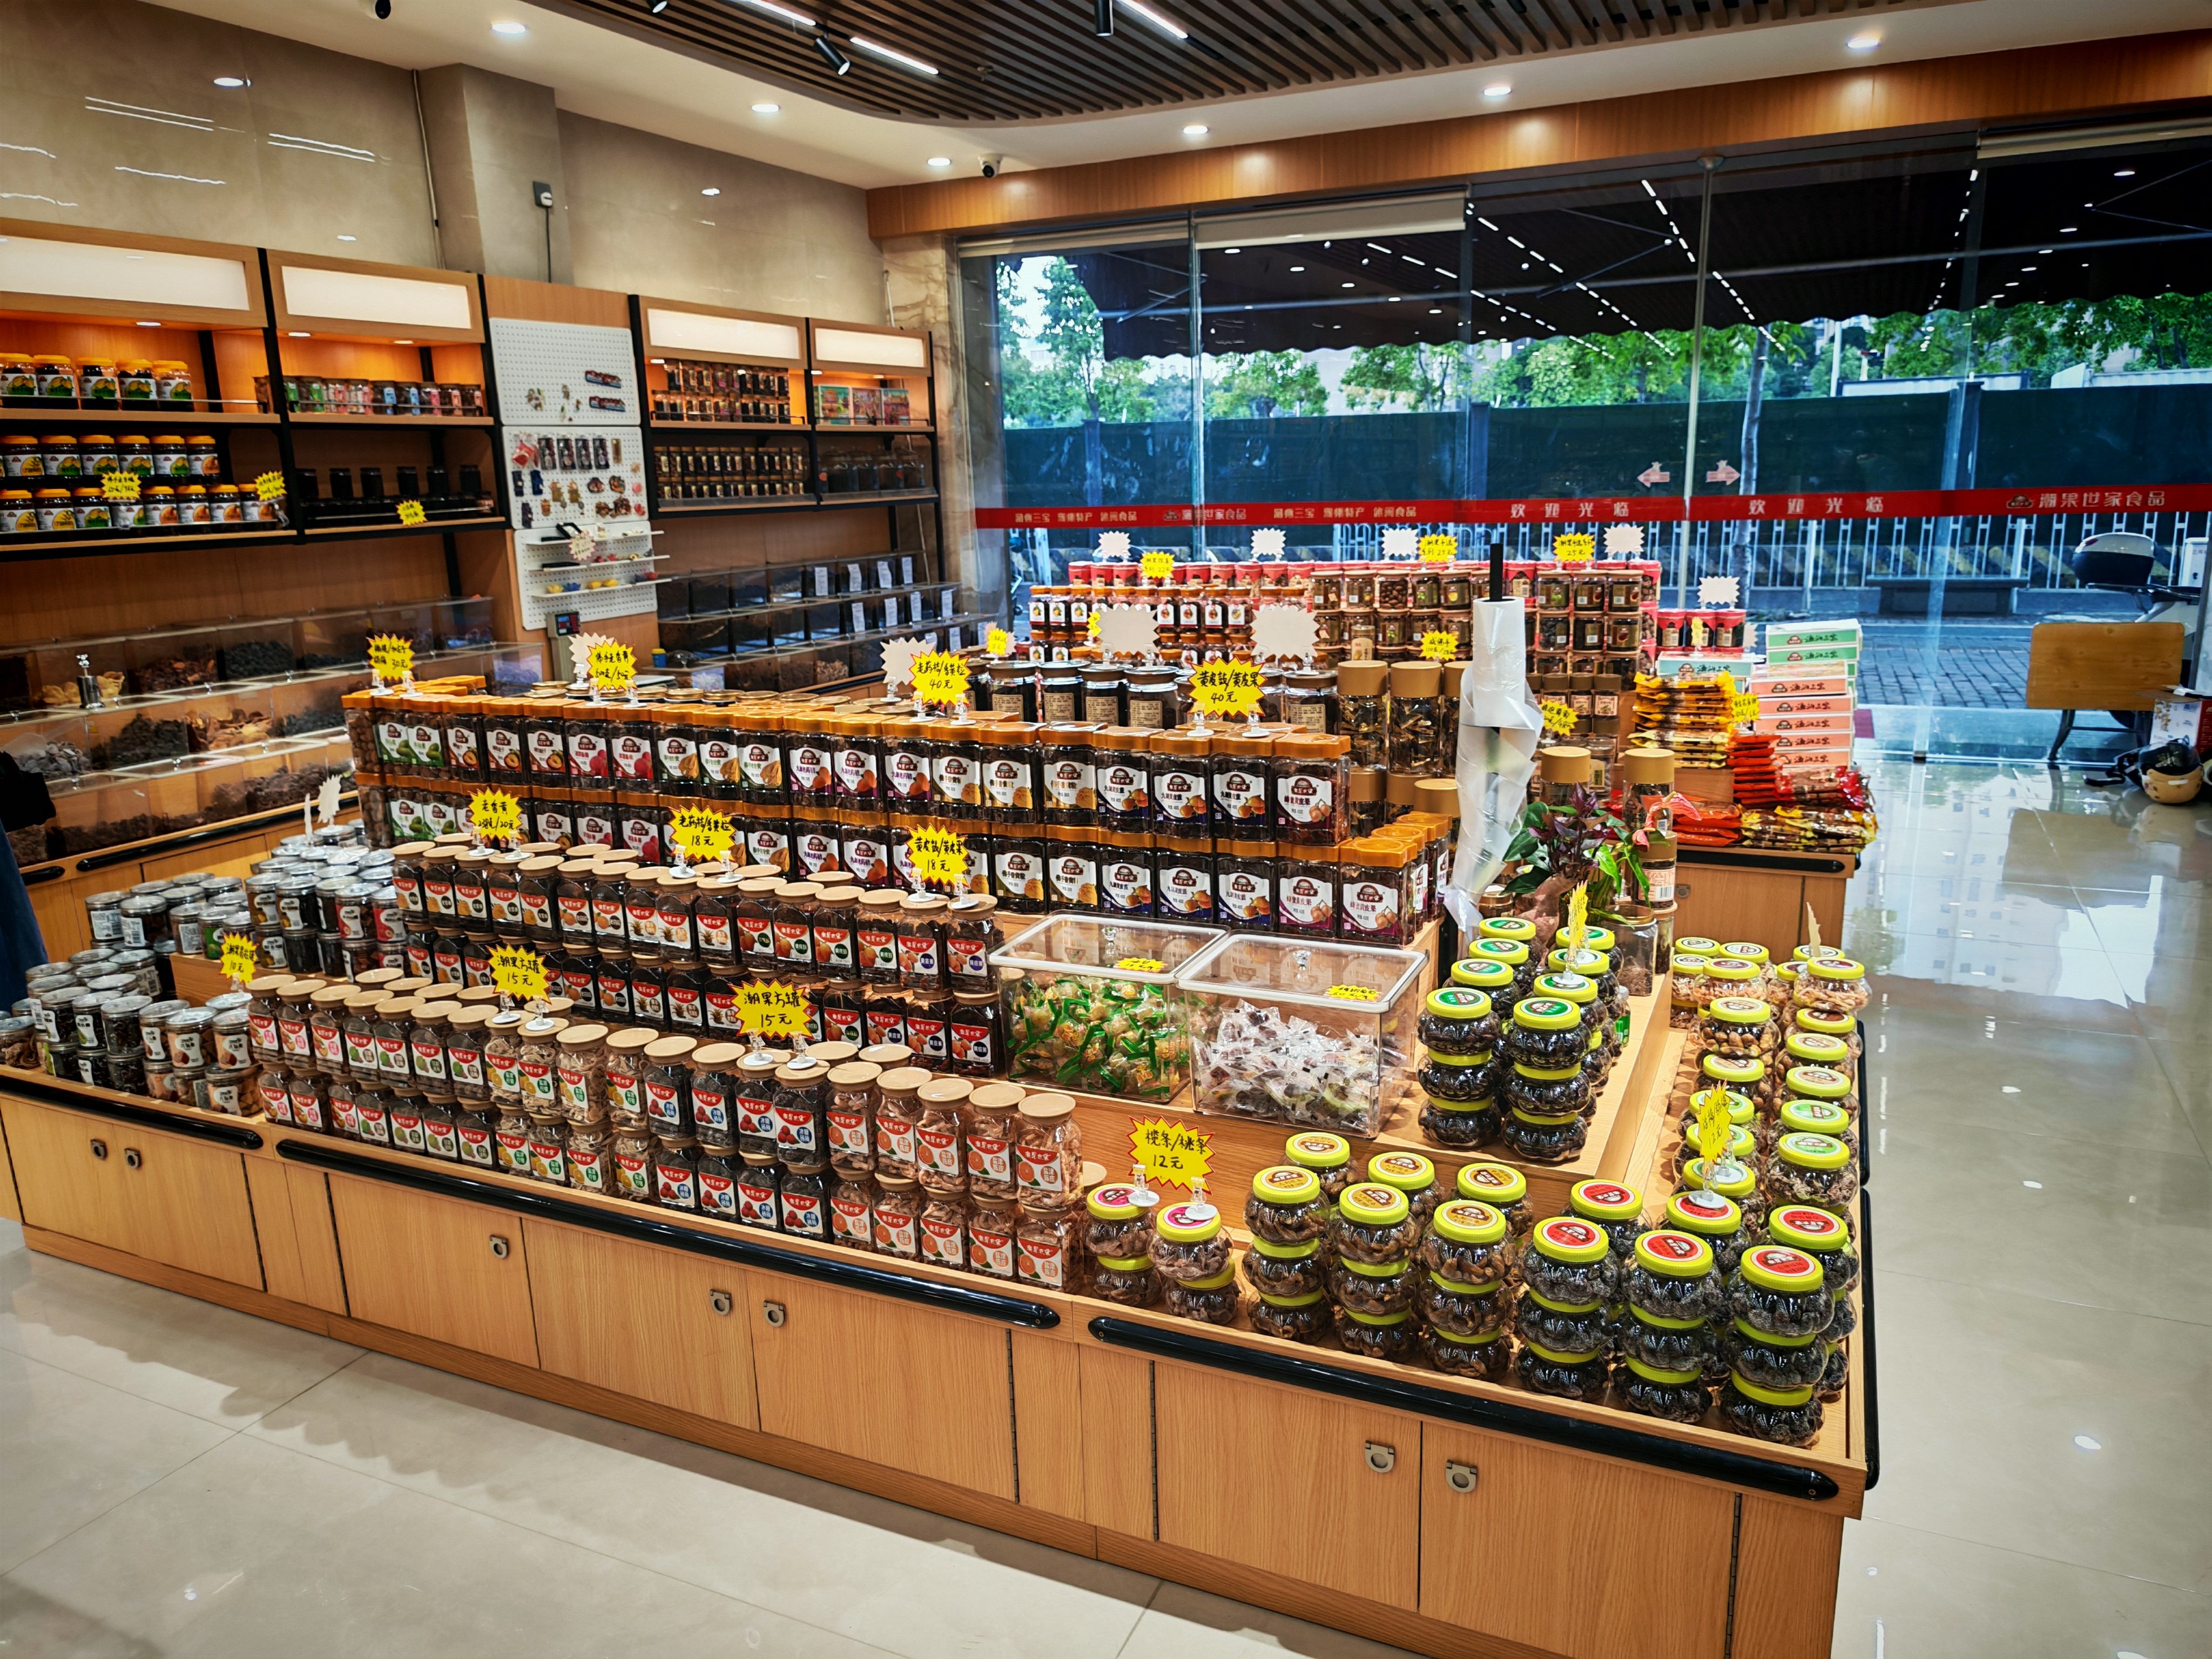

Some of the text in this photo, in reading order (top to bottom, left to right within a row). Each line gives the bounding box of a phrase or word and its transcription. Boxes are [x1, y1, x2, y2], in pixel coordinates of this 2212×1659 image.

[1748, 497, 1884, 515] 欢迎光临
[2038, 491, 2165, 508] 潮果世家食品
[1182, 509, 1246, 521] 潮世家食品
[1511, 502, 1629, 518] 欢迎光临
[929, 679, 953, 690] 40元
[1211, 691, 1238, 704] 40元
[692, 835, 714, 846] 18元
[927, 859, 950, 873] 18元
[507, 973, 532, 986] 15元
[744, 991, 800, 1008] 潮果方罐
[761, 1013, 792, 1028] 15元
[1144, 1129, 1208, 1155] 榄条/桃条
[1153, 1155, 1184, 1170] 12元
